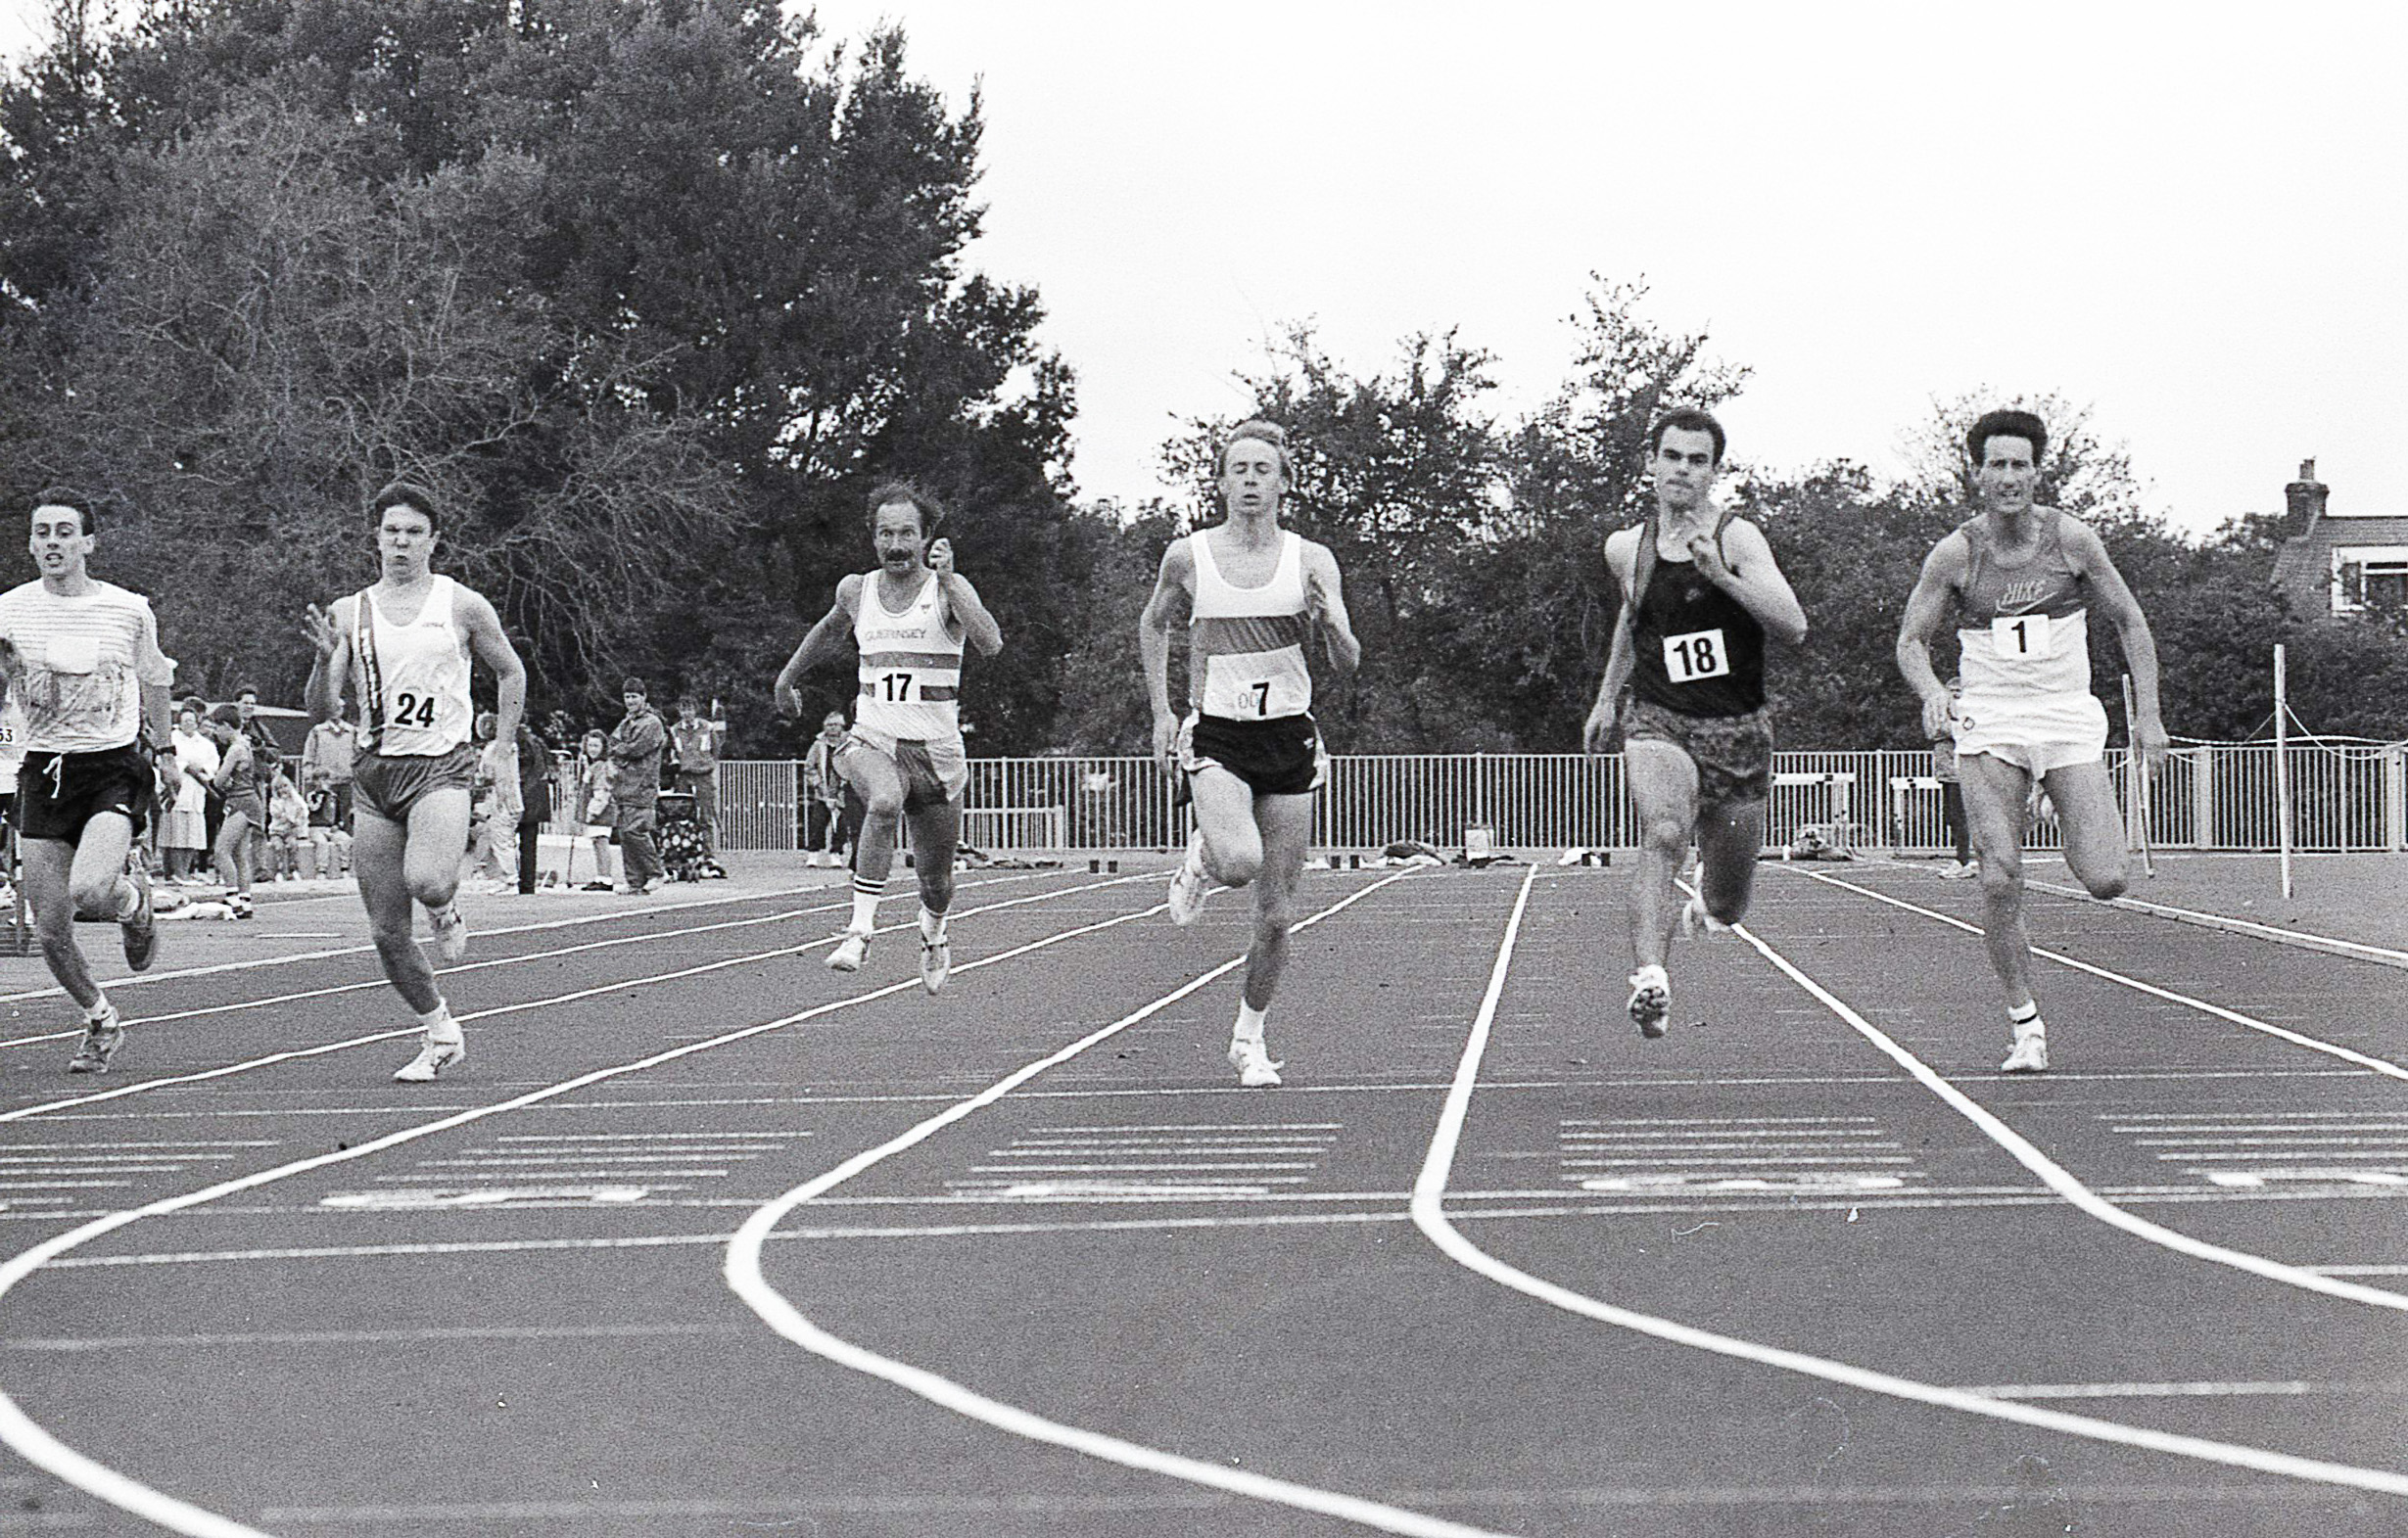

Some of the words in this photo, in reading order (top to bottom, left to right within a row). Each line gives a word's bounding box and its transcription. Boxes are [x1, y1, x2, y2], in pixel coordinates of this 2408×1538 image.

[2001, 580, 2046, 605] NIKE
[2010, 621, 2027, 653] 1
[1673, 637, 1717, 676] 18
[881, 674, 913, 702] 17
[394, 693, 435, 727] 24
